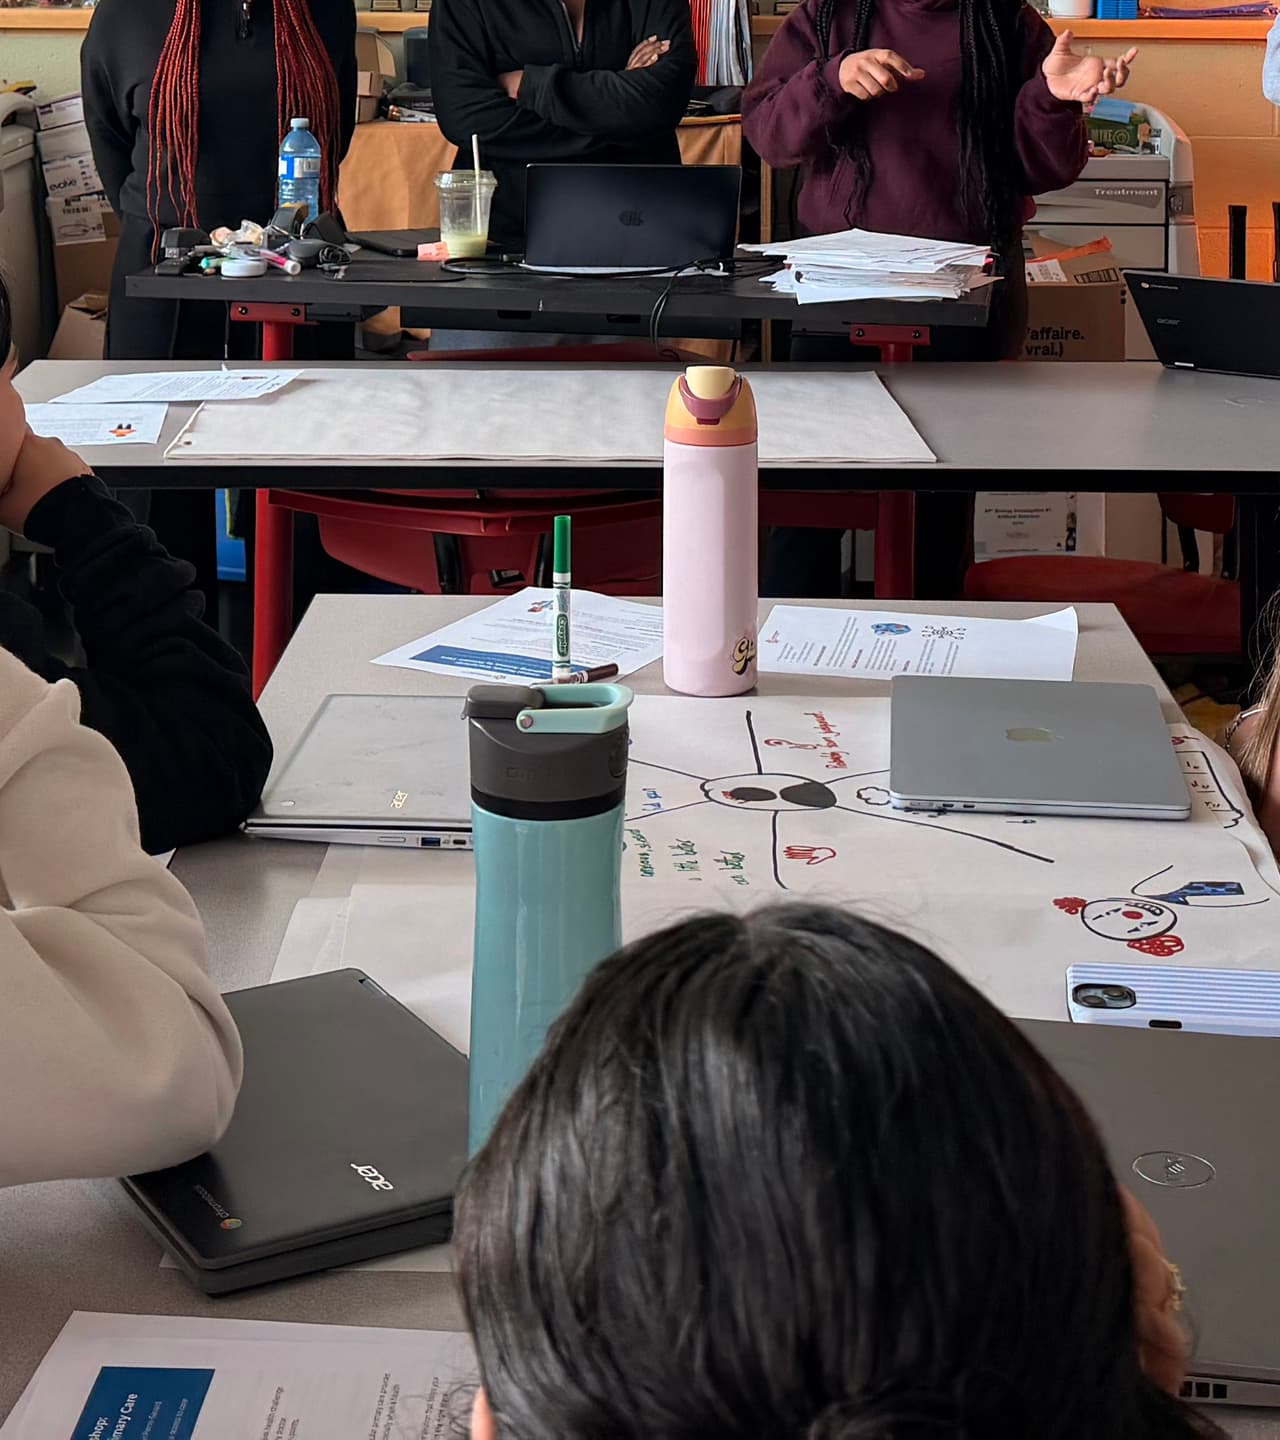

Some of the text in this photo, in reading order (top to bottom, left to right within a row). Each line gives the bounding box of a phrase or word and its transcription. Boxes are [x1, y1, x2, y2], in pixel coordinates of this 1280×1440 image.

[49, 178, 78, 191] evolve
[1094, 188, 1159, 196] Treatment
[1027, 328, 1084, 341] 'affaire.
[350, 1162, 394, 1191] acer
[120, 1393, 138, 1414] Care
